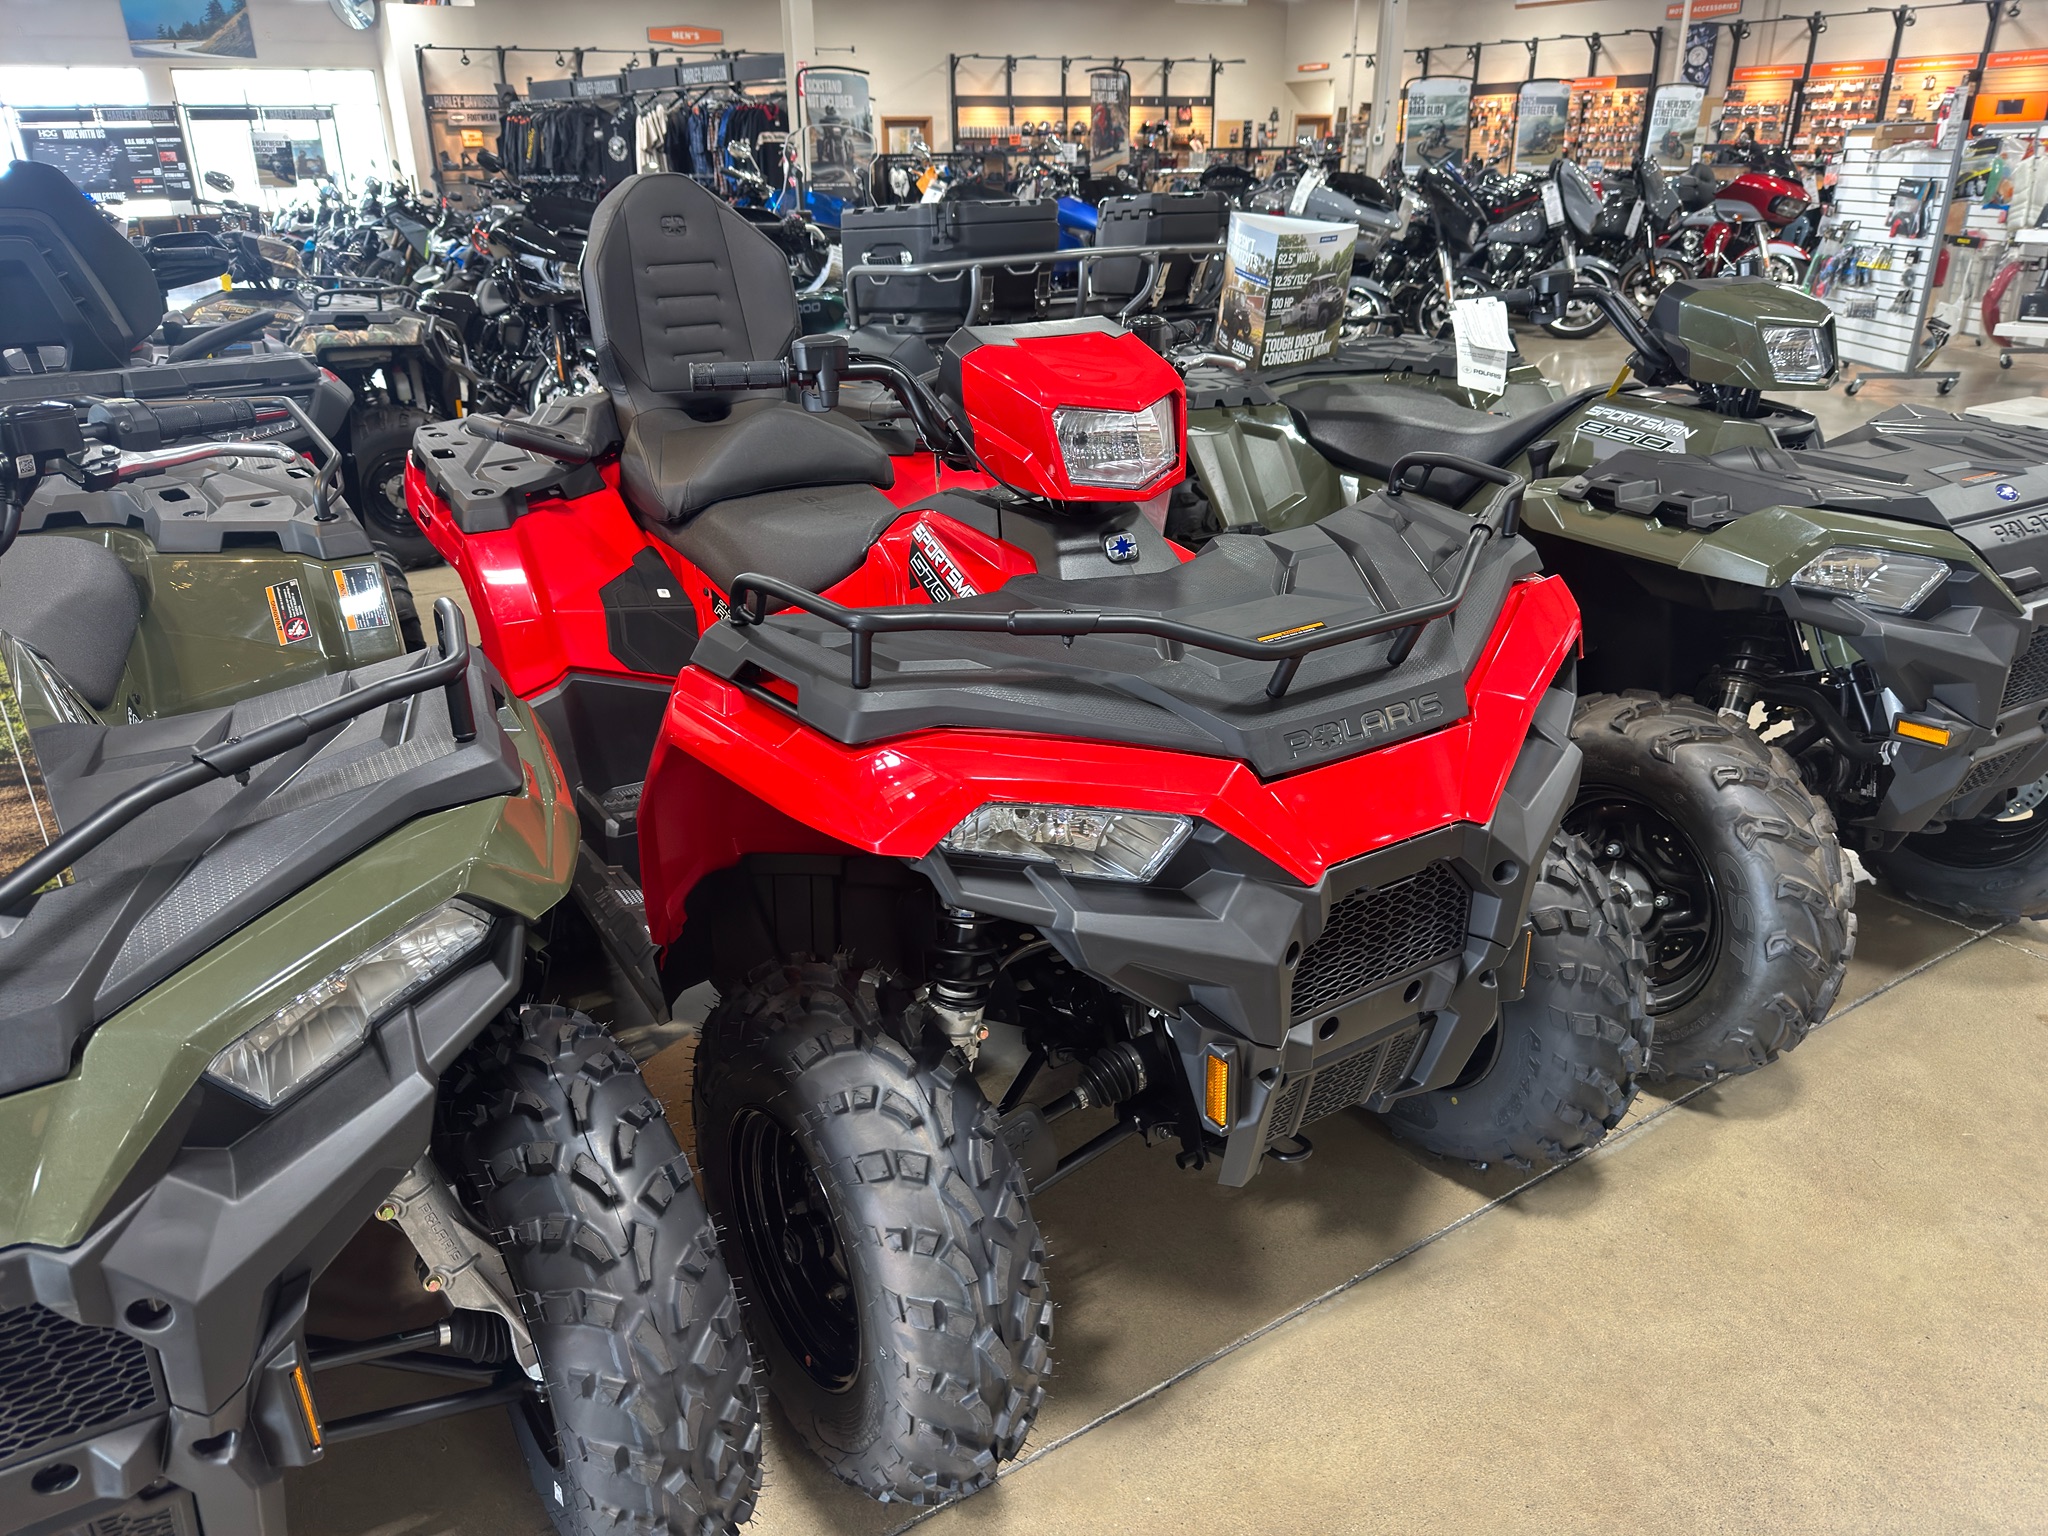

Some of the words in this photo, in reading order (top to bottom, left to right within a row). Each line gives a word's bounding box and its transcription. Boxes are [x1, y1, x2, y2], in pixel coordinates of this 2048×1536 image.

[1693, 3, 1737, 13] ACCESSORIES
[671, 31, 700, 40] MEN'S
[682, 65, 728, 84] HARLEY-DAVIDSON
[576, 79, 617, 96] HARLEY-DAVIDSON
[806, 79, 842, 93] KICKSTAND
[433, 96, 499, 107] HARLEY-DAVIDSON
[821, 94, 855, 108] INCLUDED.
[1656, 100, 1678, 108] ALL-NEW
[106, 110, 170, 120] HARLEY-DAVIDSON
[269, 110, 327, 119] HARLEY-DAVIDSON
[1409, 105, 1425, 115] ROAD
[1426, 104, 1445, 115] GLIDE
[1521, 105, 1540, 115] STREET
[1540, 105, 1556, 114] GLIDE
[1655, 109, 1673, 118] STREET
[1674, 110, 1688, 118] GLIDE
[1653, 118, 1668, 126] ULTRA
[38, 130, 58, 138] HOG
[63, 130, 79, 139] RIDE
[79, 130, 96, 139] WITH
[96, 129, 105, 138] US
[1278, 252, 1296, 265] 62.5"
[1296, 251, 1316, 264] WIDTH
[1271, 298, 1284, 309] 100
[1284, 297, 1294, 308] HP
[1265, 336, 1294, 352] TOUGH
[1294, 330, 1326, 349] DOESN'T
[1245, 344, 1254, 358] LB.
[1262, 348, 1304, 366] CONSIDER
[1304, 346, 1313, 360] IT
[1473, 368, 1502, 380] POLARIS
[1584, 405, 1698, 439] SPORTSMAN
[1576, 419, 1676, 452] 850
[1990, 512, 2048, 542] POLAR
[911, 522, 978, 598] SPORTSMA
[909, 551, 951, 603] 570
[1283, 691, 1444, 759] POLARIS
[1717, 851, 1756, 976] CST
[418, 1202, 463, 1261] POLARIS
